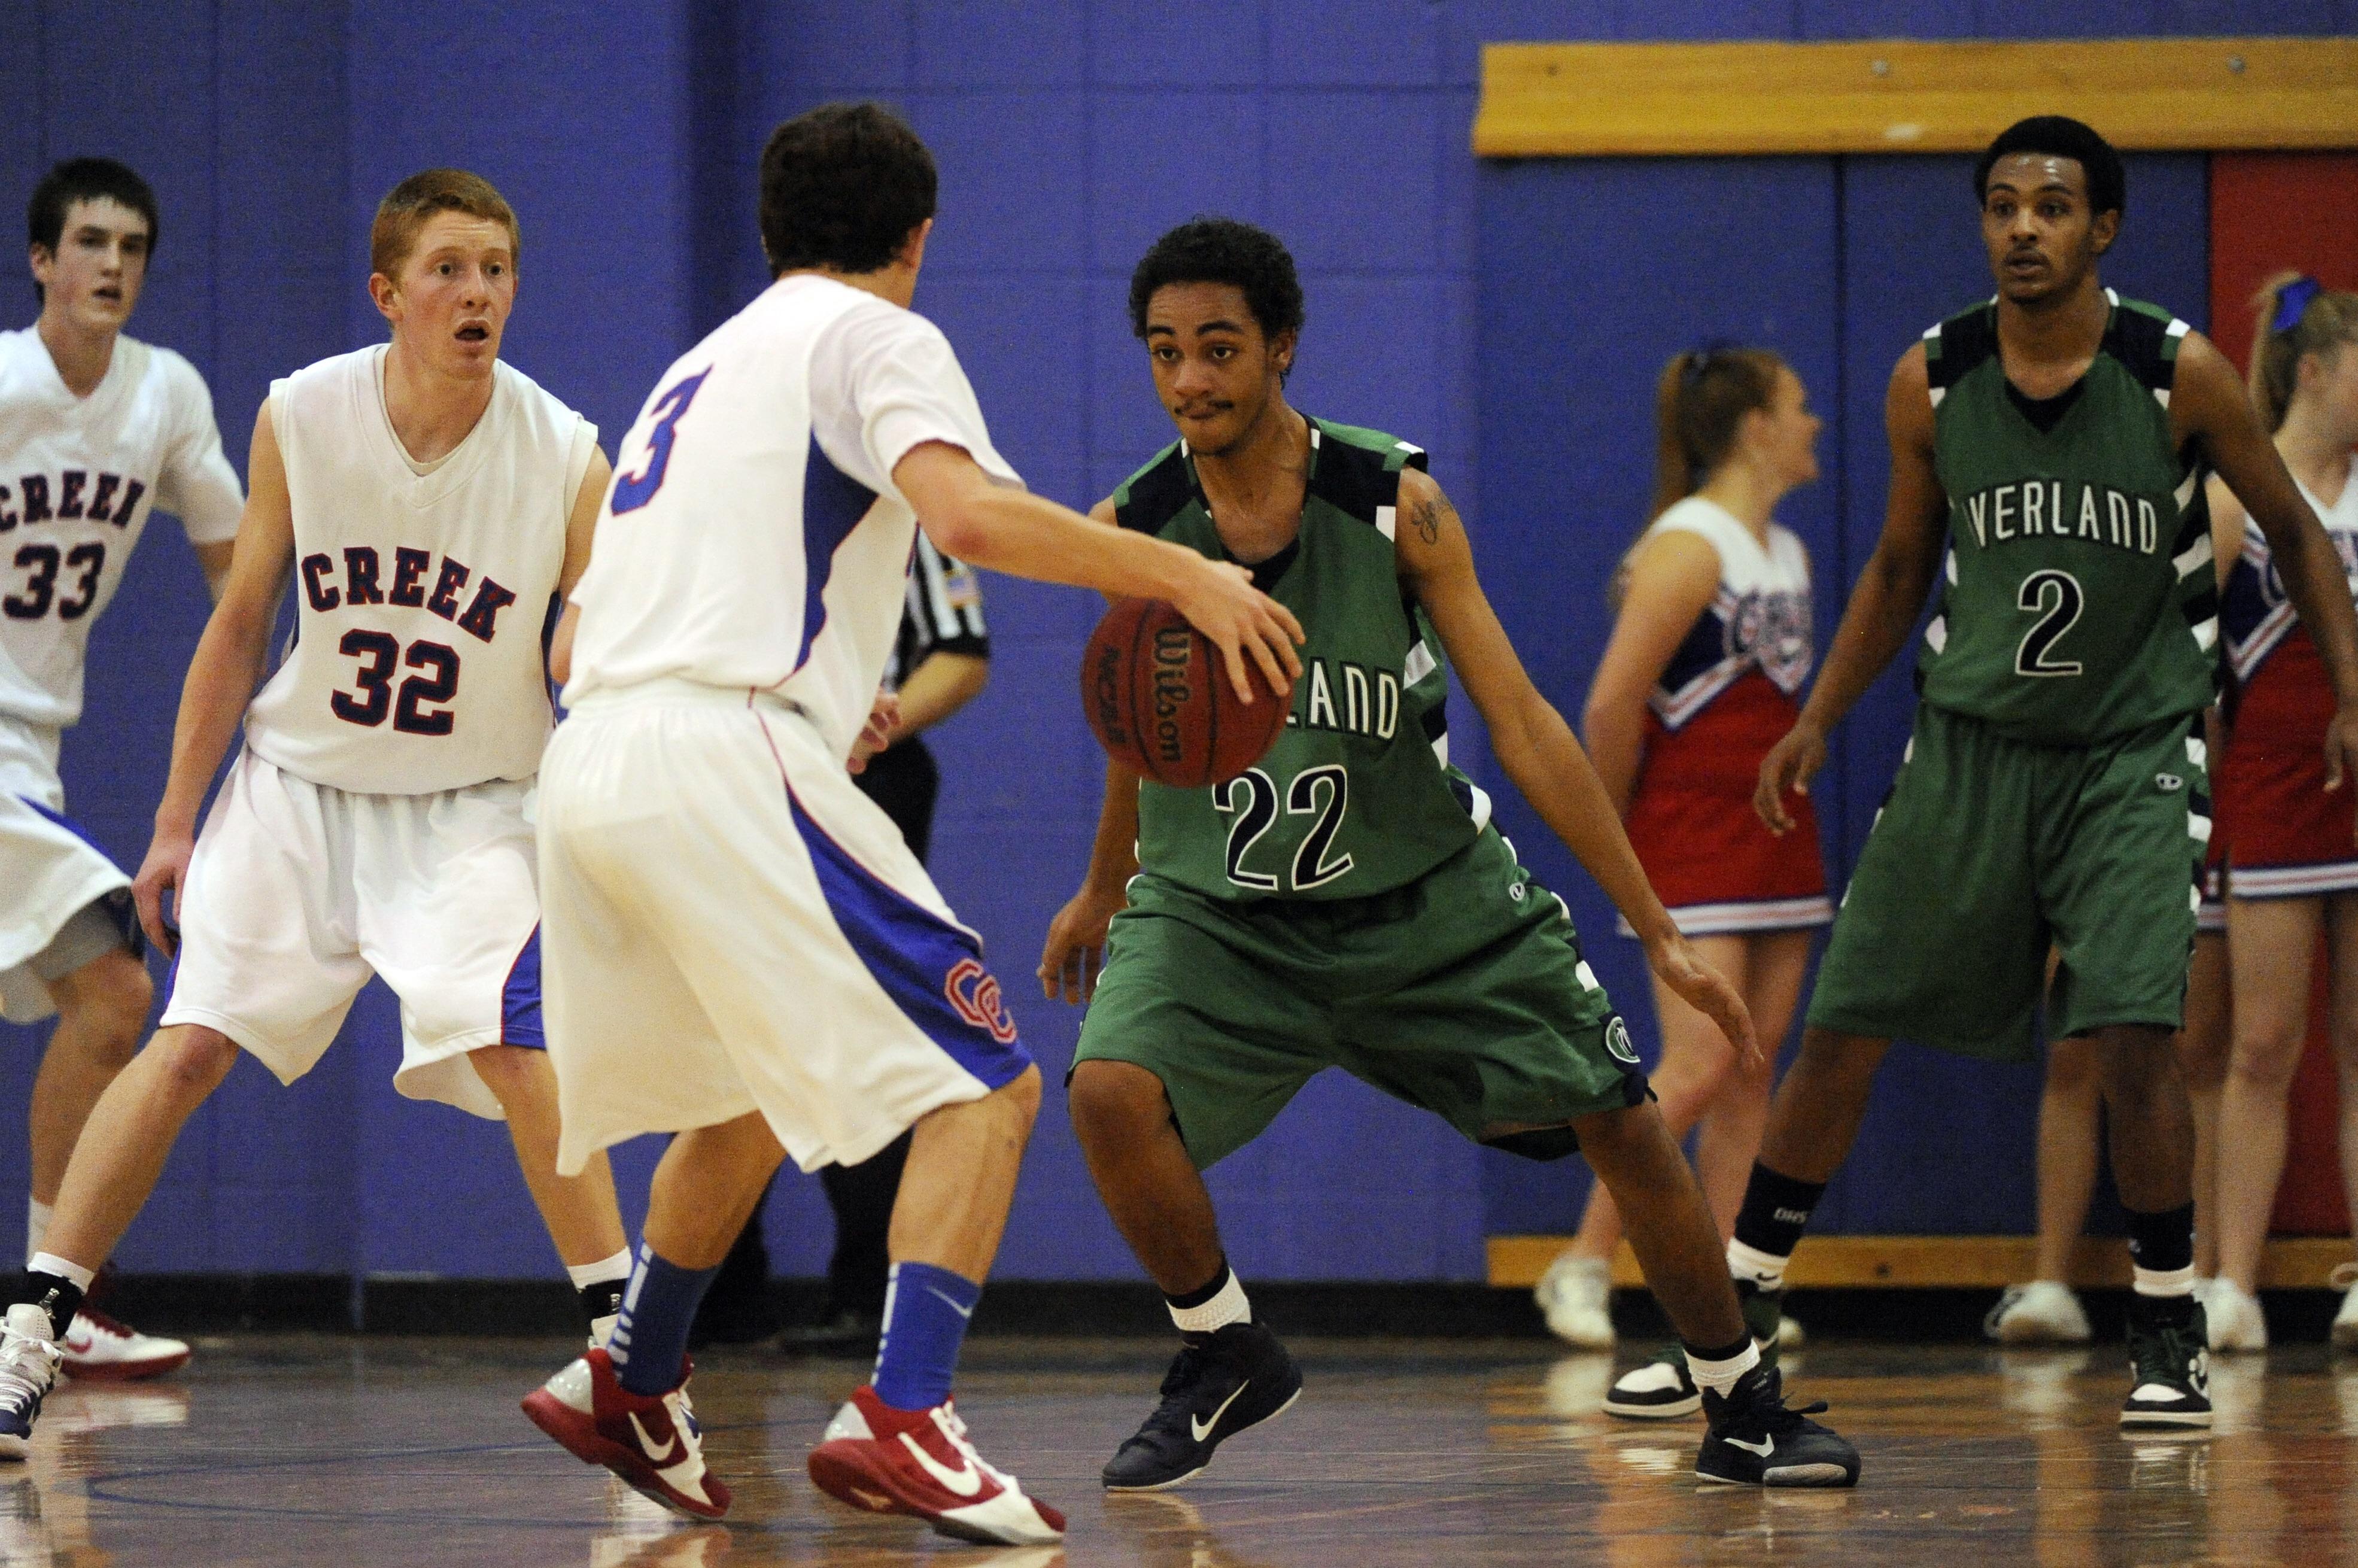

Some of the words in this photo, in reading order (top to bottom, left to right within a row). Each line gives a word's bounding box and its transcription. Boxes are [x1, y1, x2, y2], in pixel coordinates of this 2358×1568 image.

[610, 362, 713, 516] 3
[1963, 481, 2158, 555] VERLAND
[3, 540, 106, 621] 33
[301, 546, 517, 644] CREEK
[2015, 569, 2084, 677] 2
[330, 628, 461, 736] 32
[1153, 624, 1192, 762] Wilson
[1212, 767, 1354, 892] 22
